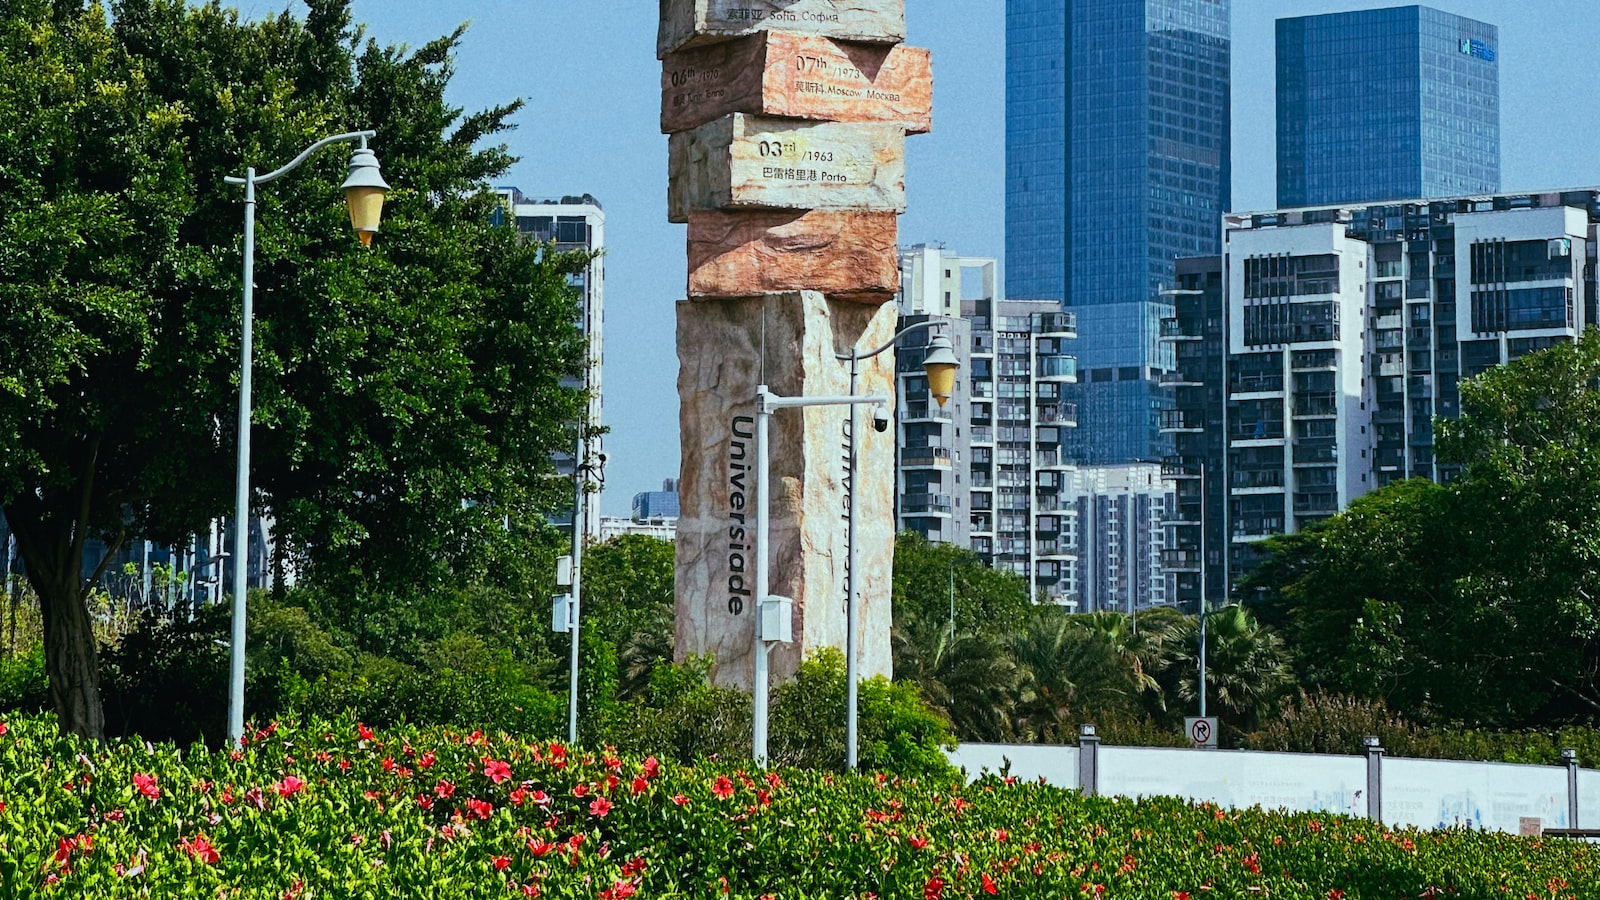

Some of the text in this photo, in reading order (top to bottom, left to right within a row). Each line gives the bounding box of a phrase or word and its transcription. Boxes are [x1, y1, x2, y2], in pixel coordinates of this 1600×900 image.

[801, 11, 839, 23] София
[796, 55, 827, 75] 07th
[671, 67, 695, 87] 06th
[801, 151, 833, 161] /1963
[821, 171, 847, 182] Porto
[728, 415, 754, 616] Universiade
